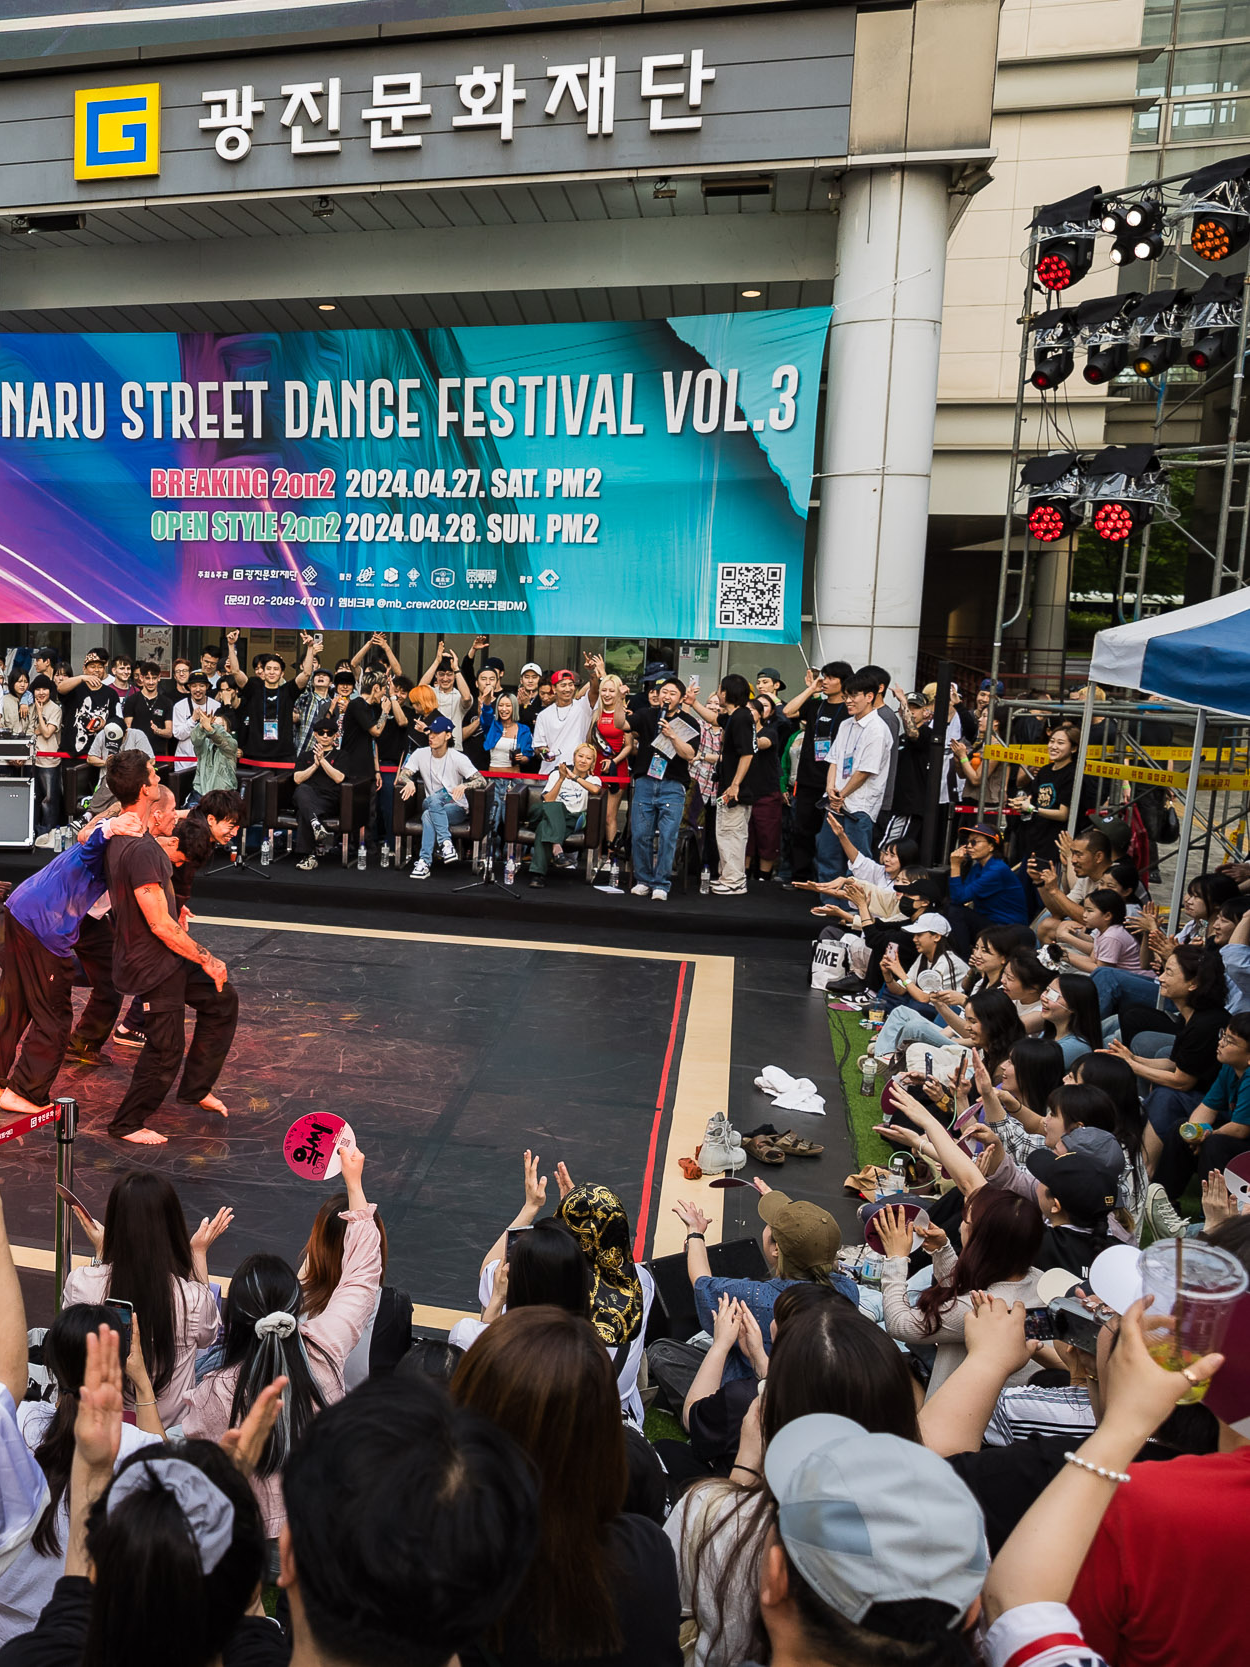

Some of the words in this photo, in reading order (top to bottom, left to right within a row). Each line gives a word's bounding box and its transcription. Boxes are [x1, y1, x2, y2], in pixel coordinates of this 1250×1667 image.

[198, 49, 717, 161] 광진문화재단
[1, 381, 105, 439] NARU
[121, 380, 268, 440] STREET
[285, 378, 421, 438] DANCE
[438, 373, 644, 438] FESTIVAL
[662, 364, 800, 434] VOL.3
[150, 468, 268, 500] BREAKING
[272, 468, 336, 500] 2on2
[345, 468, 485, 499] 2024.04.27.
[490, 468, 540, 498] SAT.
[545, 468, 603, 498] PM2
[151, 511, 209, 542] OPEN
[211, 511, 279, 542] STYLE
[280, 511, 340, 543] 2on2
[345, 513, 481, 543] 2024.04.28.
[486, 513, 541, 543] SUN.
[546, 513, 600, 543] PM2
[244, 569, 299, 582] 광진문화재단
[224, 595, 250, 606] [문의]
[252, 596, 325, 607] 02-2049-4700
[338, 597, 375, 608] 엠비크루
[1147, 772, 1174, 784] 출입금지
